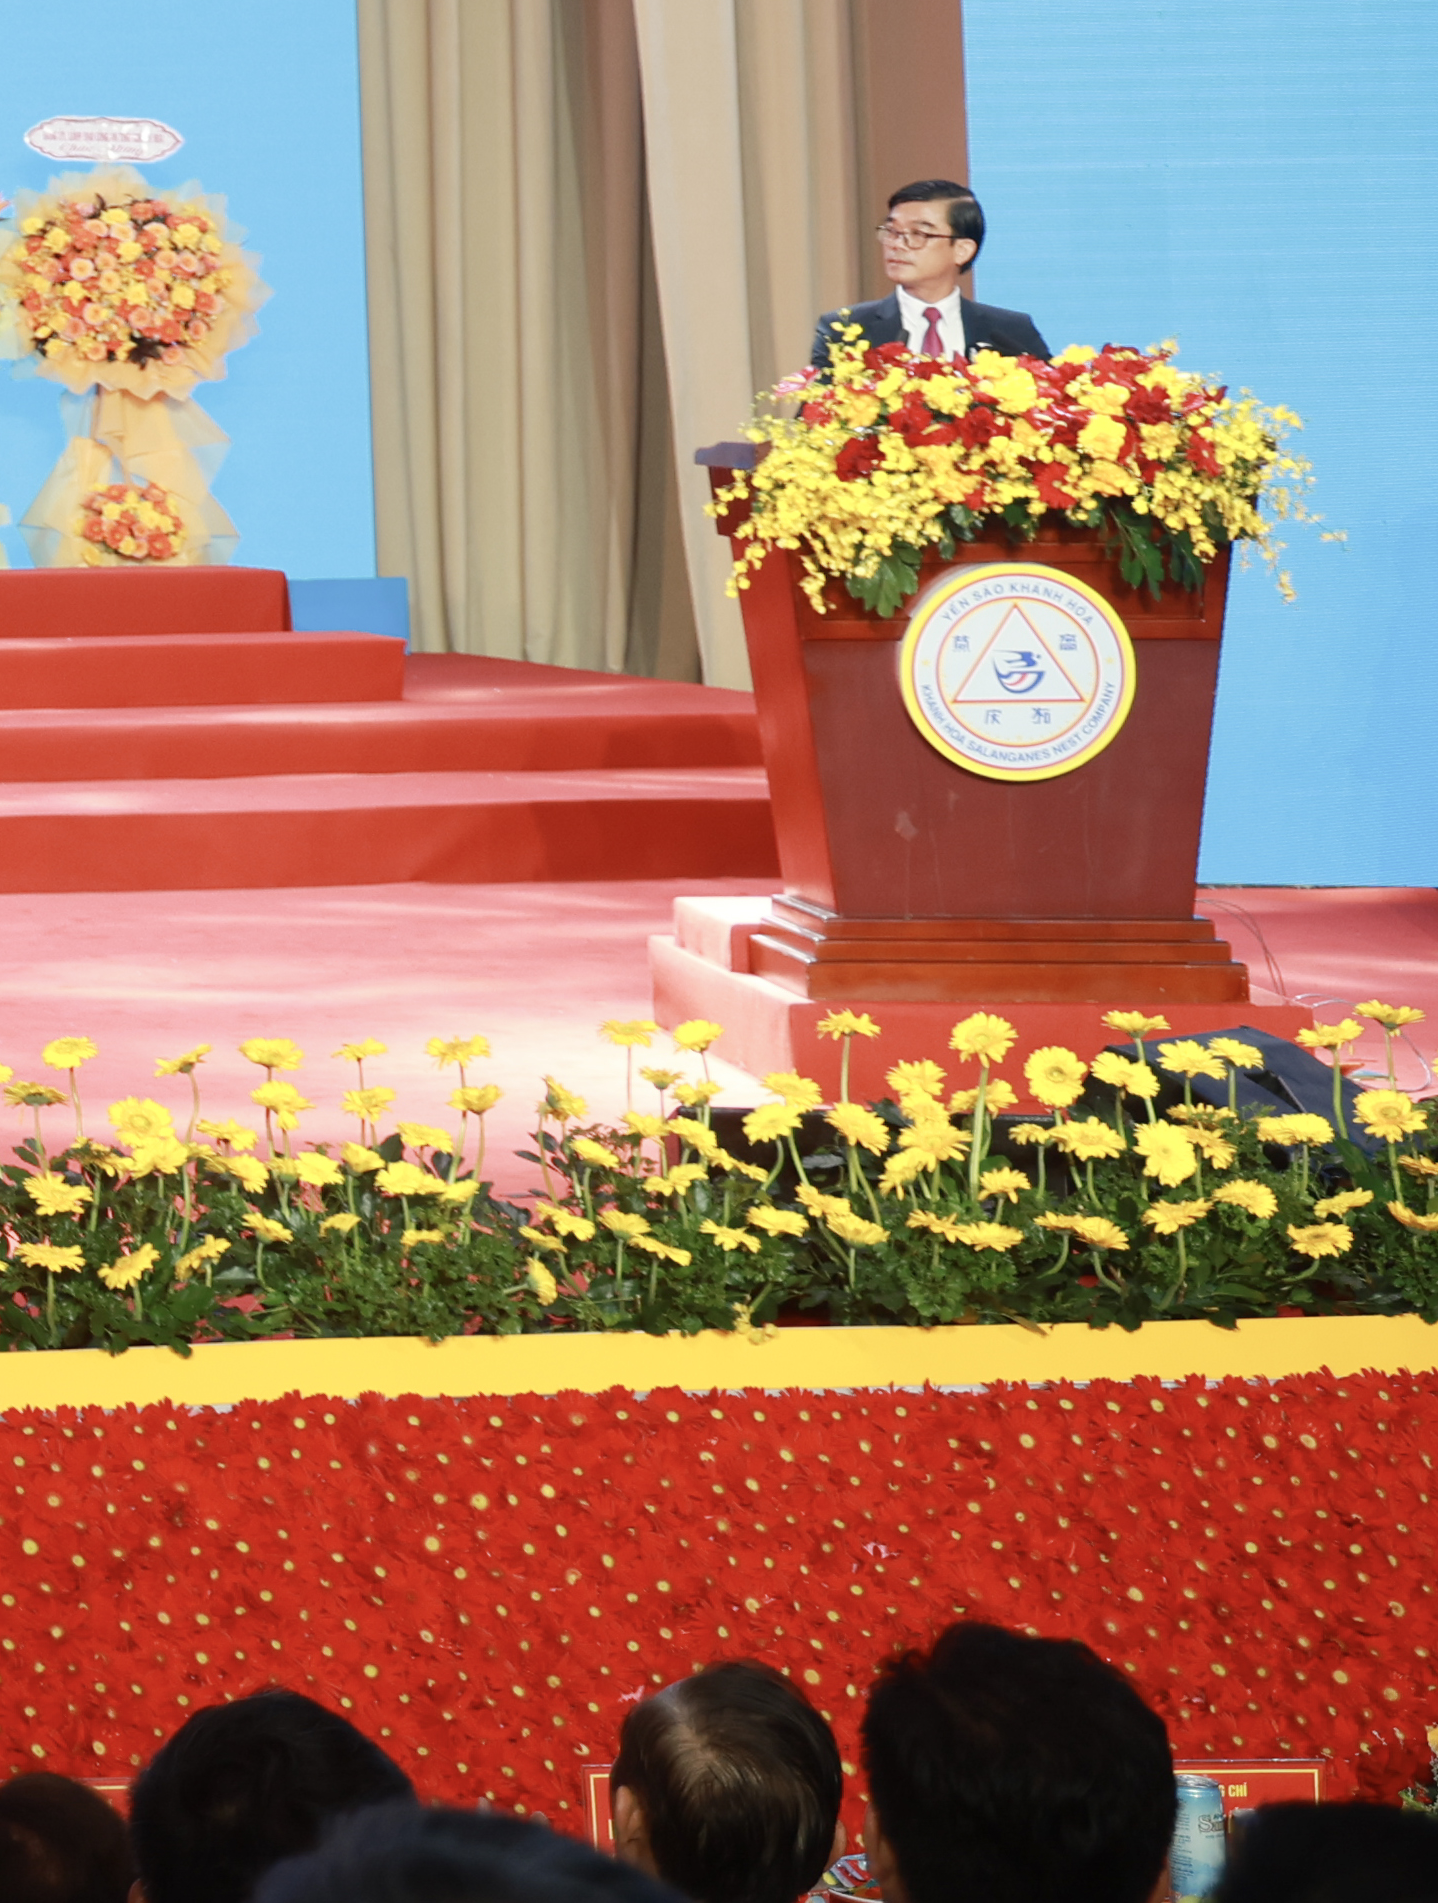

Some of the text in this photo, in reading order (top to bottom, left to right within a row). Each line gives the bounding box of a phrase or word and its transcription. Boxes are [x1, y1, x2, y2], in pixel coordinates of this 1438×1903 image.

[944, 722, 965, 745] HOA
[967, 740, 1051, 763] SALANGANES
[1052, 733, 1083, 756] NEST
[1083, 682, 1115, 735] COMPANY
[1228, 1782, 1248, 1797] CHÍ
